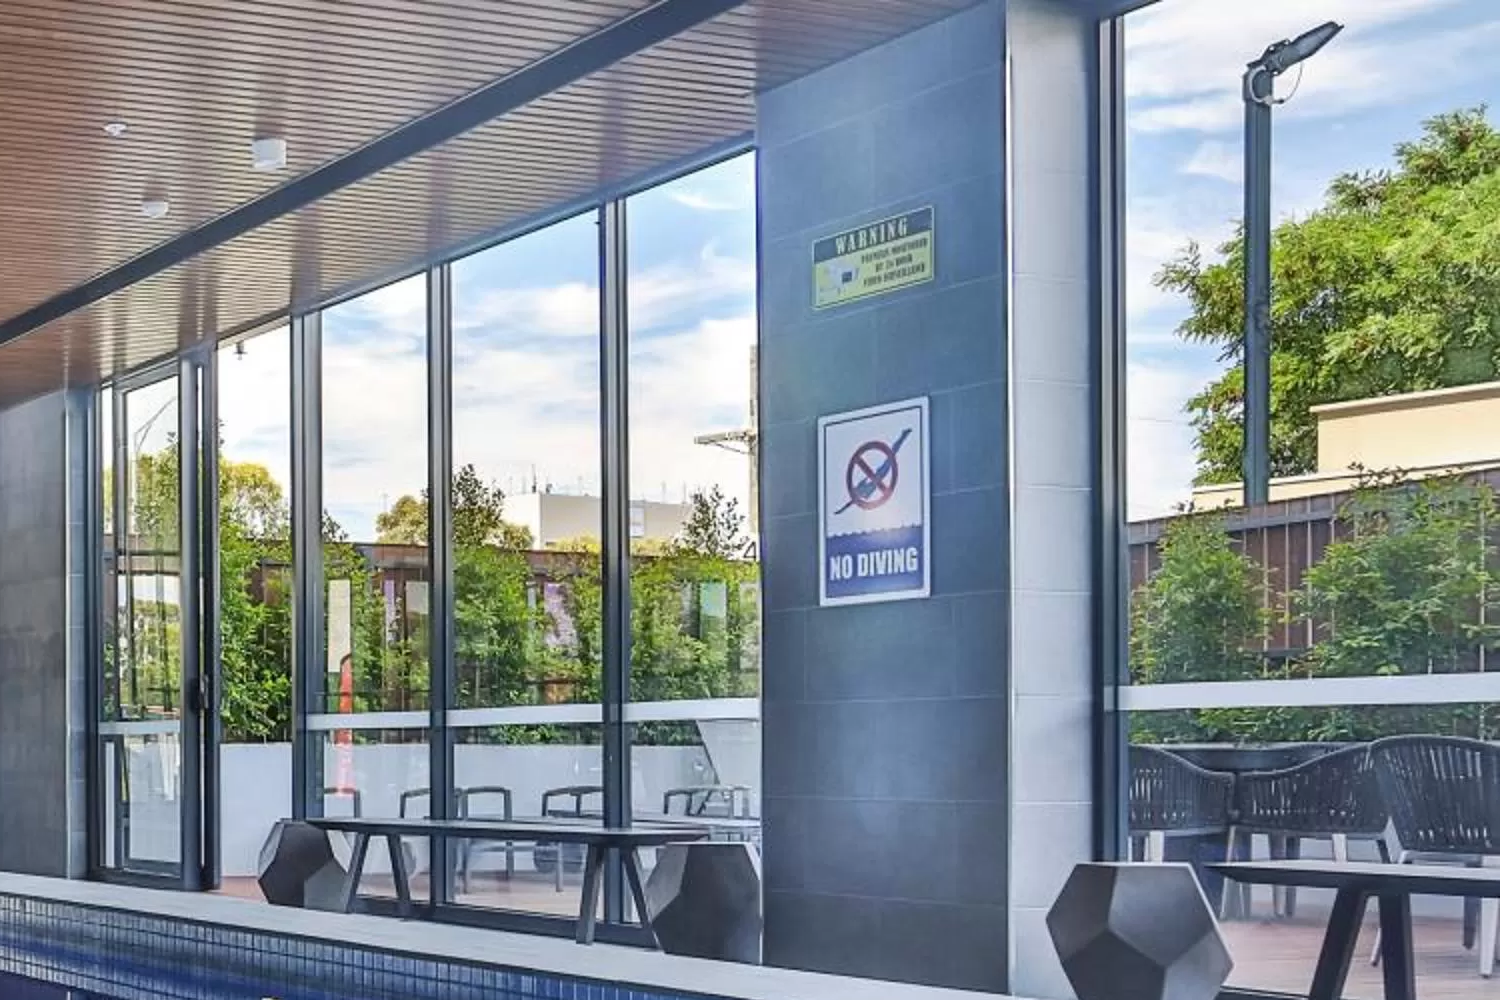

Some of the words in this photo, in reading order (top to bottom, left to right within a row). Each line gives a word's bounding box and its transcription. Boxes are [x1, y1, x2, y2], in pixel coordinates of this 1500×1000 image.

[835, 217, 908, 254] WARNING
[829, 554, 852, 581] NO
[857, 547, 919, 577] DIVING
